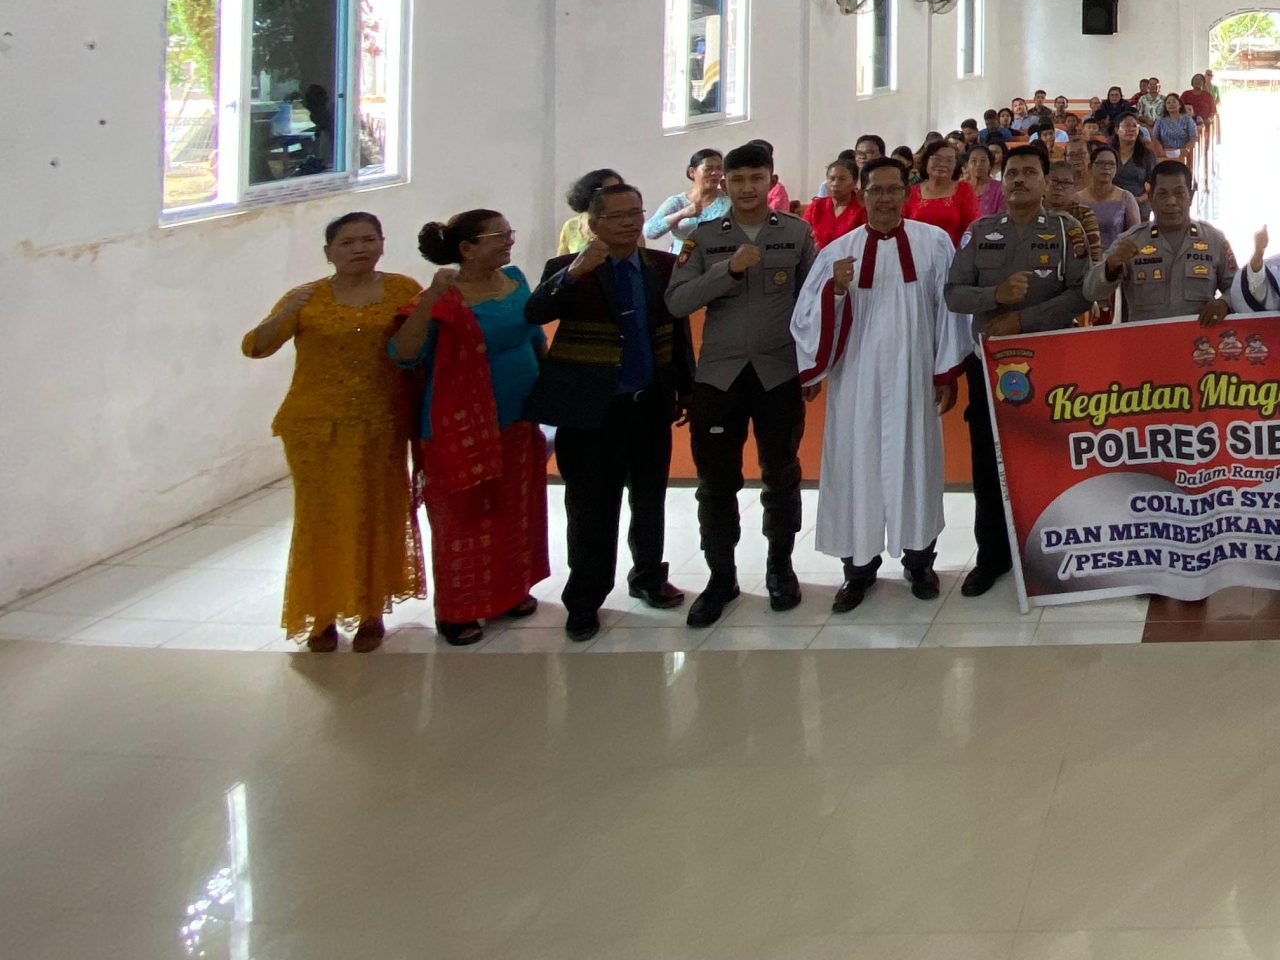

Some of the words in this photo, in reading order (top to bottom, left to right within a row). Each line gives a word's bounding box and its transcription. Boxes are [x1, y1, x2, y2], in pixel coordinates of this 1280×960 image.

[1031, 242, 1059, 250] POLRI
[1187, 253, 1213, 262] POLRI
[1048, 383, 1191, 426] Kegiatan
[1072, 425, 1217, 466] POLRES
[1177, 467, 1227, 486] Dalam
[1130, 490, 1234, 516] COLLING
[1044, 525, 1102, 548] DAN
[1062, 549, 1162, 574] /PESAN
[1168, 542, 1247, 572] PESAN
